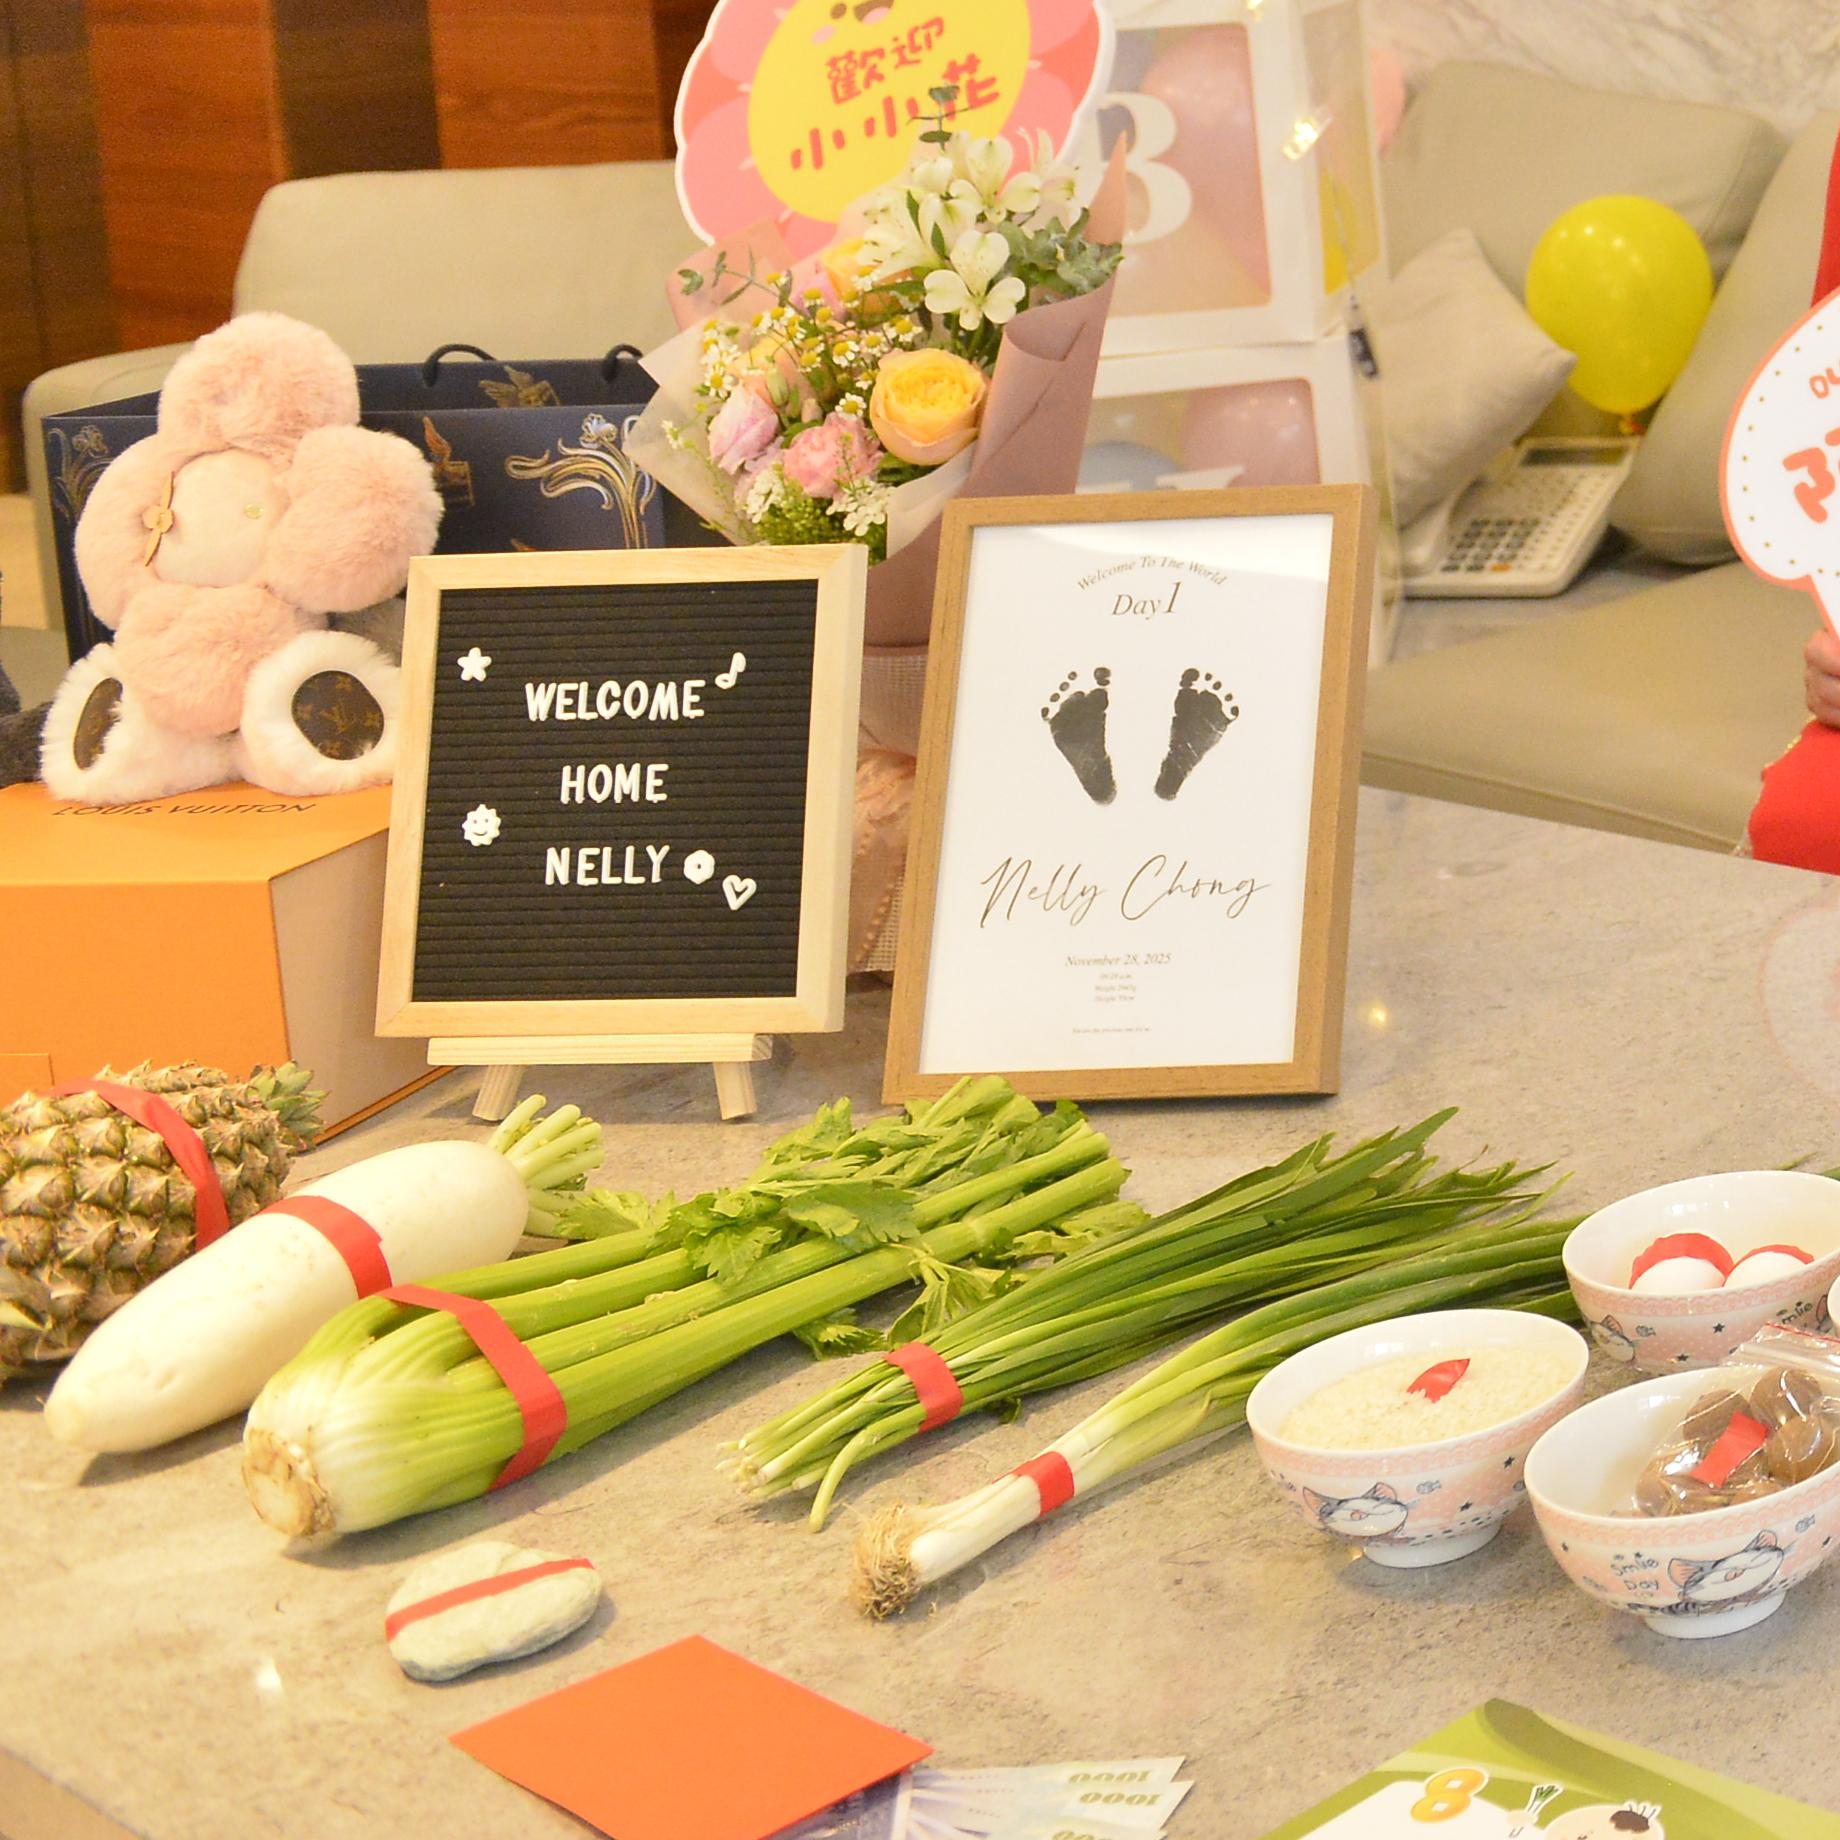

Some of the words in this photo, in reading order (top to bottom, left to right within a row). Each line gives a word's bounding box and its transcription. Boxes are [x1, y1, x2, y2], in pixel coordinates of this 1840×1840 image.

[825, 16, 946, 105] 歡迎
[790, 52, 1001, 171] 小小花
[1077, 560, 1137, 591] Welcome
[1140, 555, 1157, 569] To
[1160, 556, 1185, 569] The
[1188, 561, 1228, 586] World
[525, 680, 706, 722] WELCOME
[560, 763, 669, 805] HOME
[52, 805, 162, 816] LOUIS
[168, 803, 318, 815] VUITTON
[545, 845, 670, 886] NELLY
[980, 856, 1107, 929] Nelly
[1120, 854, 1272, 921] Chong
[1064, 955, 1121, 967] November
[1610, 1552, 1660, 1577] Smile
[1410, 1768, 1488, 1824] 8
